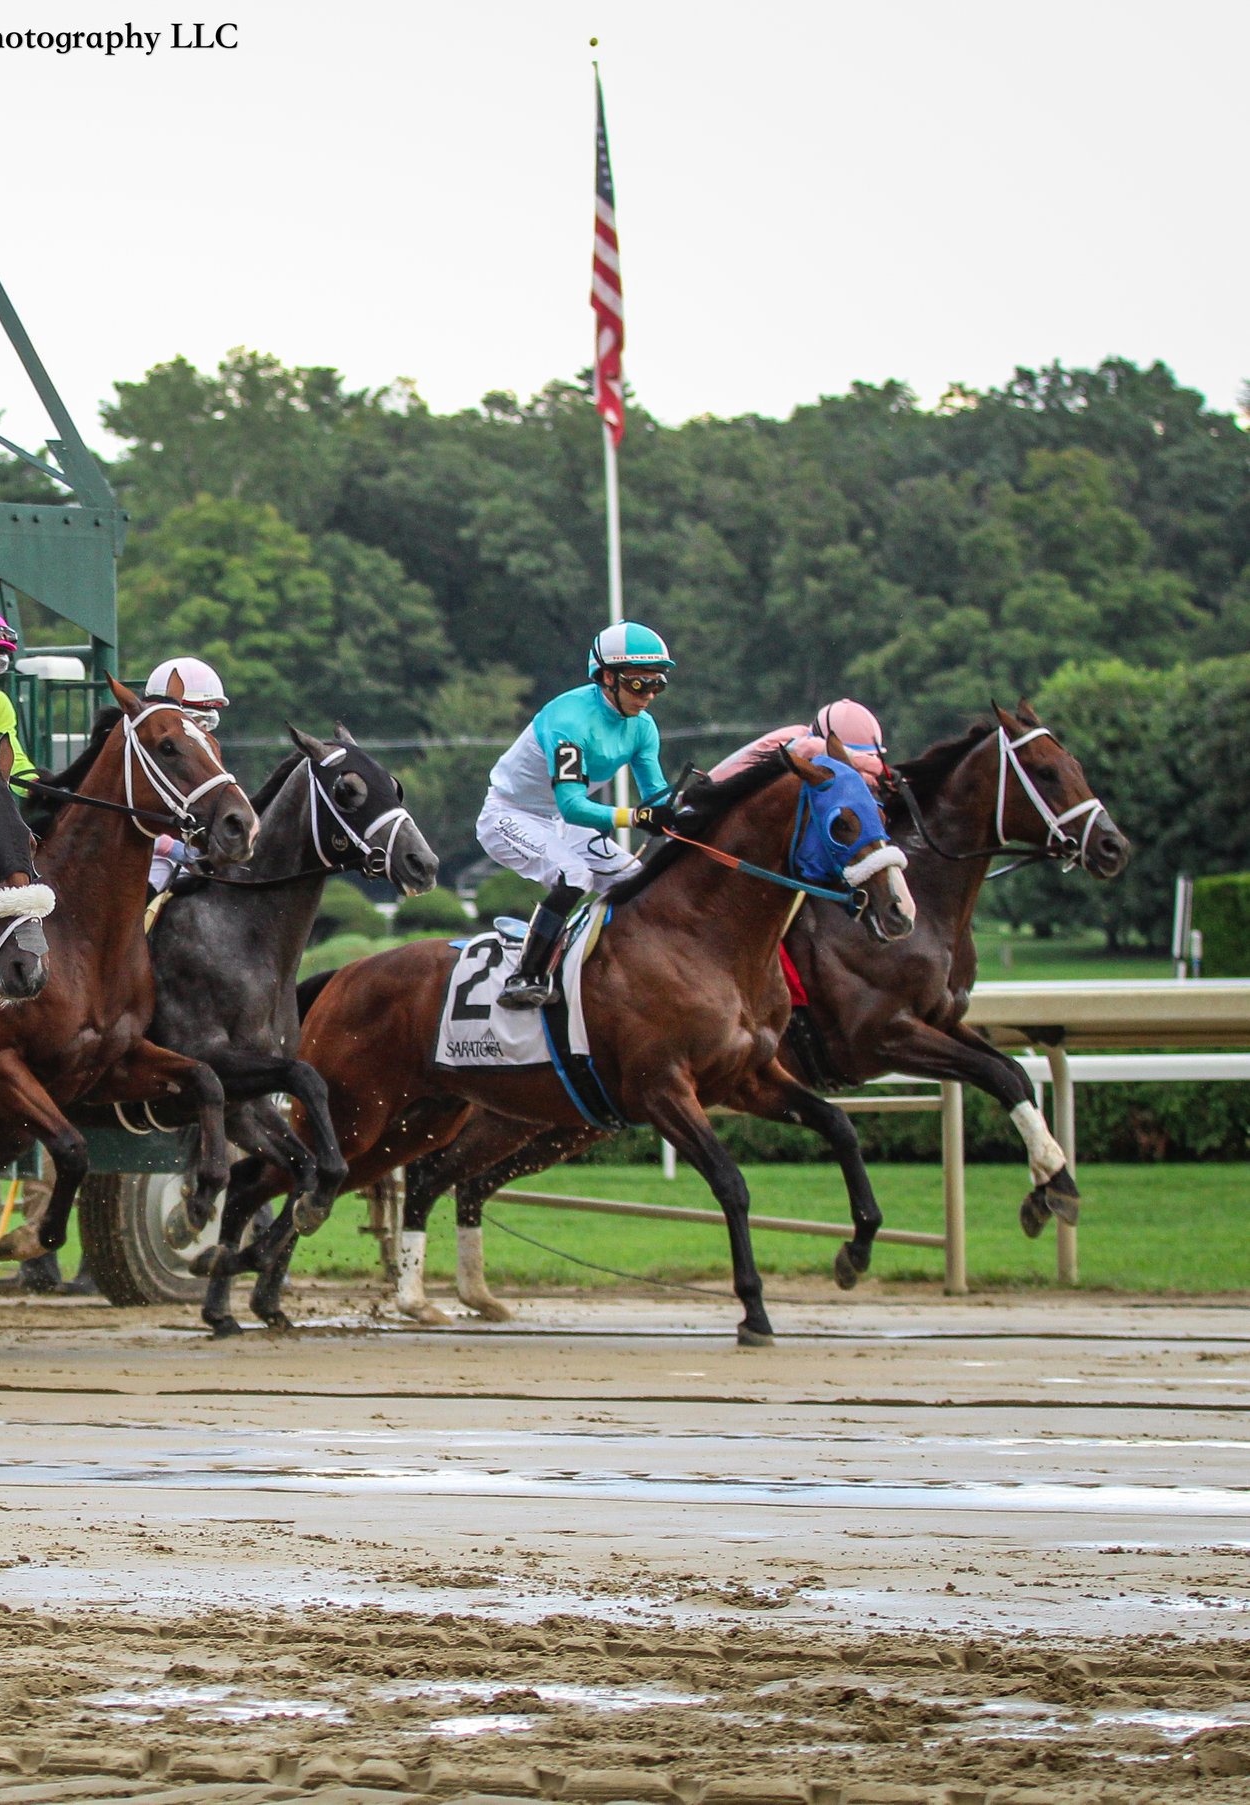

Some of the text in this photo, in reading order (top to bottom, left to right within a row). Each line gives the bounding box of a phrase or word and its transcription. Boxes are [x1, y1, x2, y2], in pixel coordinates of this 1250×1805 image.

[559, 747, 578, 779] 2
[451, 938, 504, 1021] 2
[444, 1040, 505, 1058] SARATOGA
